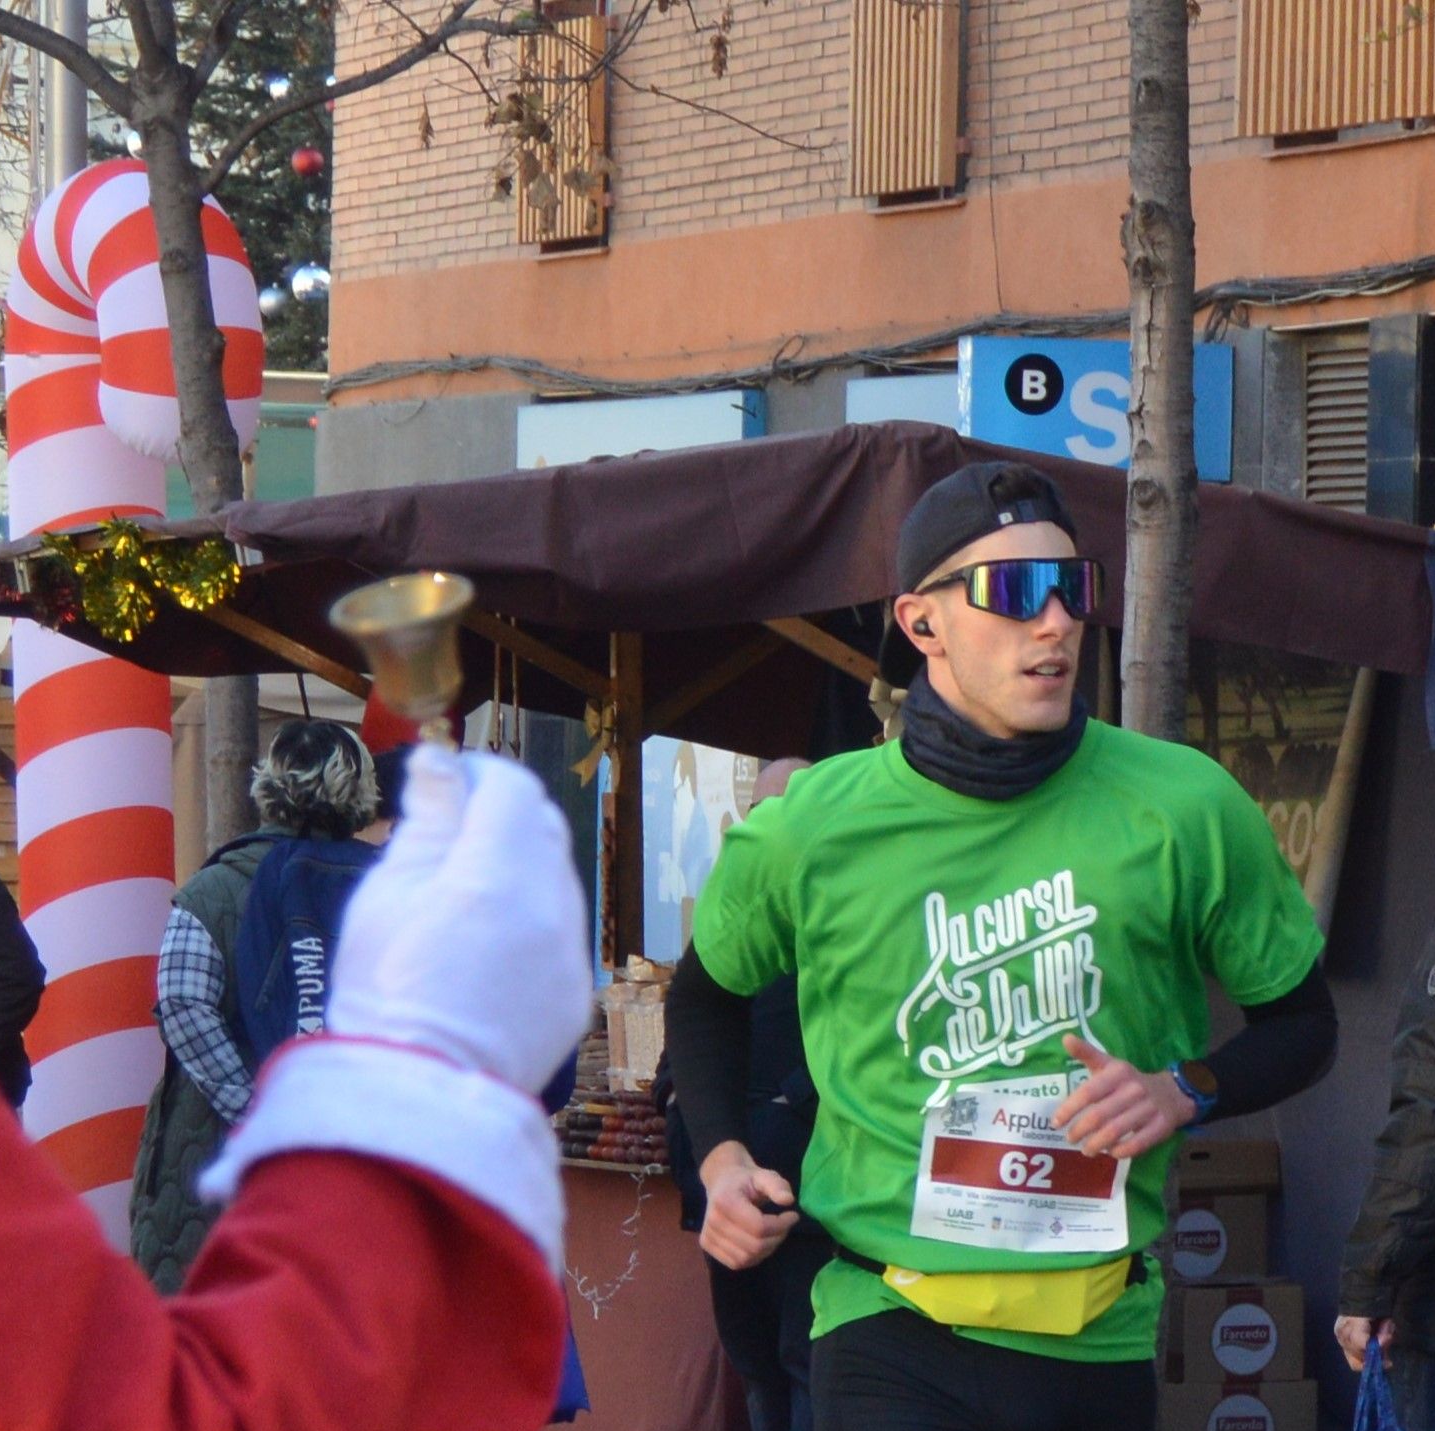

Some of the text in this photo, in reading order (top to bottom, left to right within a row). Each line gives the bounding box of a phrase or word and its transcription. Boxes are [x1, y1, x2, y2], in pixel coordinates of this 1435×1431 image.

[1022, 369, 1047, 401] B
[291, 936, 325, 1014] PUMA
[999, 1150, 1055, 1189] 62
